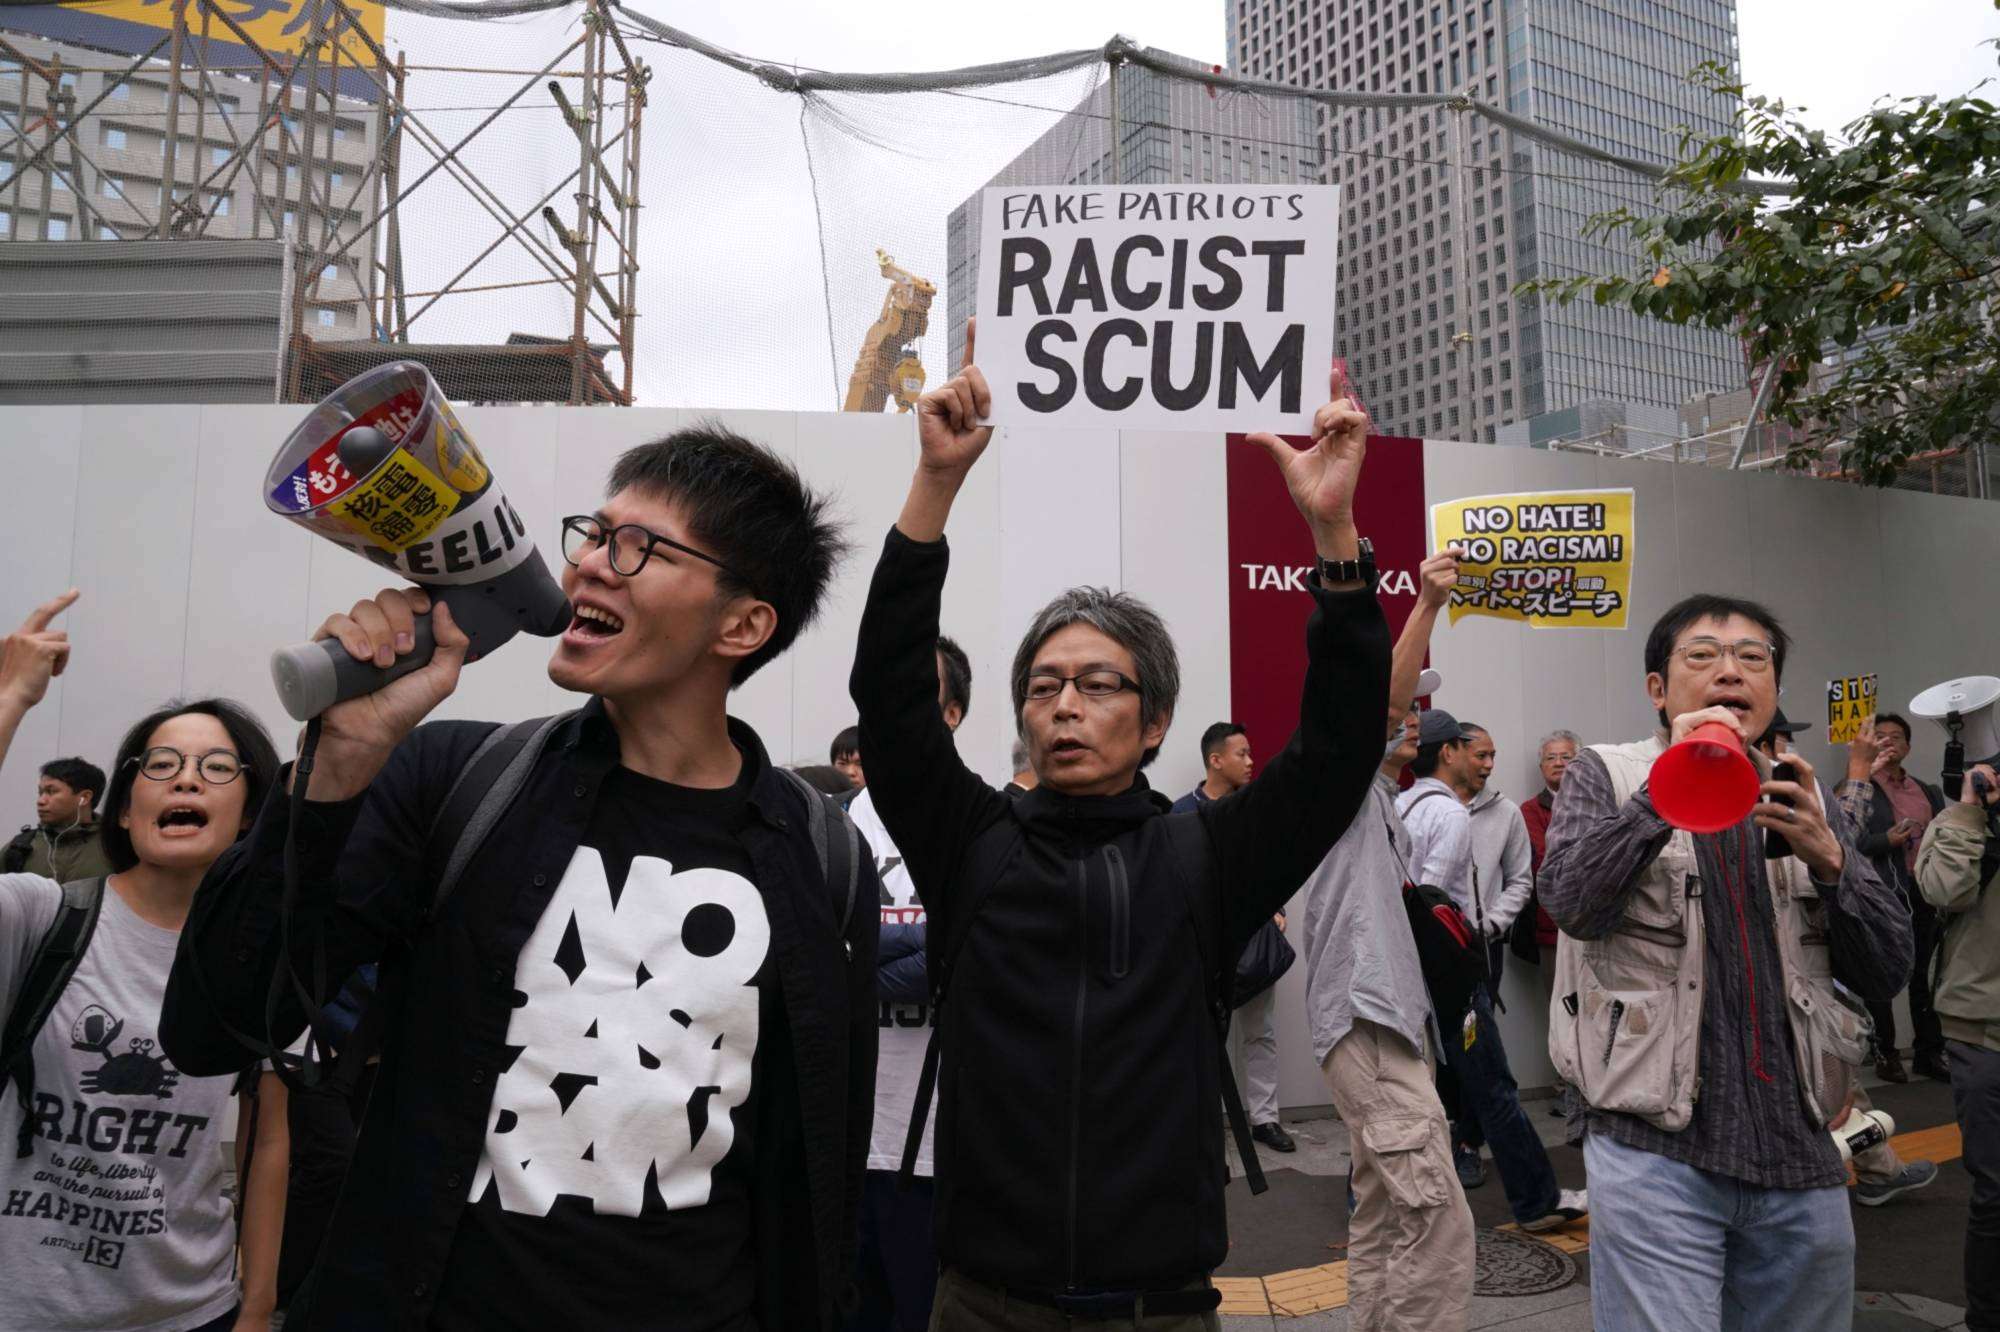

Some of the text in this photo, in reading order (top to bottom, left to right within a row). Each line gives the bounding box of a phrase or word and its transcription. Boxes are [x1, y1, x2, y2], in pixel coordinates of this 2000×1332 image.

[1002, 191, 1304, 231] FAKE PATRIOTS
[997, 234, 1305, 317] RACIST
[1017, 318, 1305, 415] SCUM
[1463, 504, 1604, 533] NO HATE!
[1448, 535, 1622, 563] NO RACISM!
[1241, 563, 1417, 595] TAKKA
[1491, 568, 1575, 591] STOP!
[1449, 589, 1621, 617] ヘイト・スピーチ
[34, 1092, 210, 1159] RIGHT
[51, 1152, 66, 1168] to
[62, 1177, 90, 1195] the
[89, 1186, 150, 1202] pursuit
[1, 1189, 168, 1236] HAPPINES
[40, 1235, 121, 1267] ARTICLE 13
